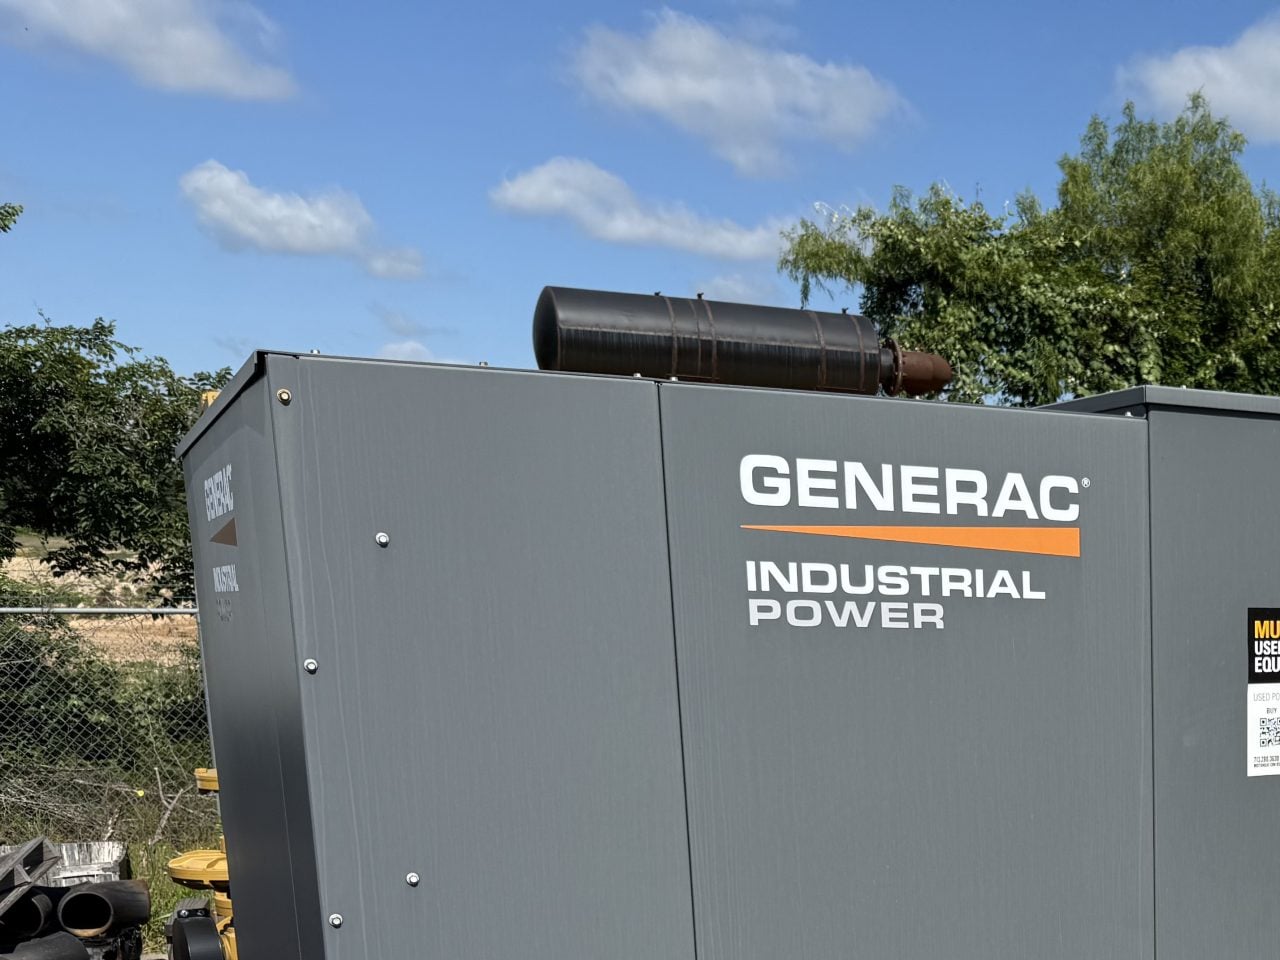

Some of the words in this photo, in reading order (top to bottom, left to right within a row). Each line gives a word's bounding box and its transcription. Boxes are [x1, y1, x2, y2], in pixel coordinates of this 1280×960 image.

[746, 561, 1046, 599] INDUSTRIAL
[748, 599, 944, 628] POWER
[1253, 692, 1271, 702] USED
